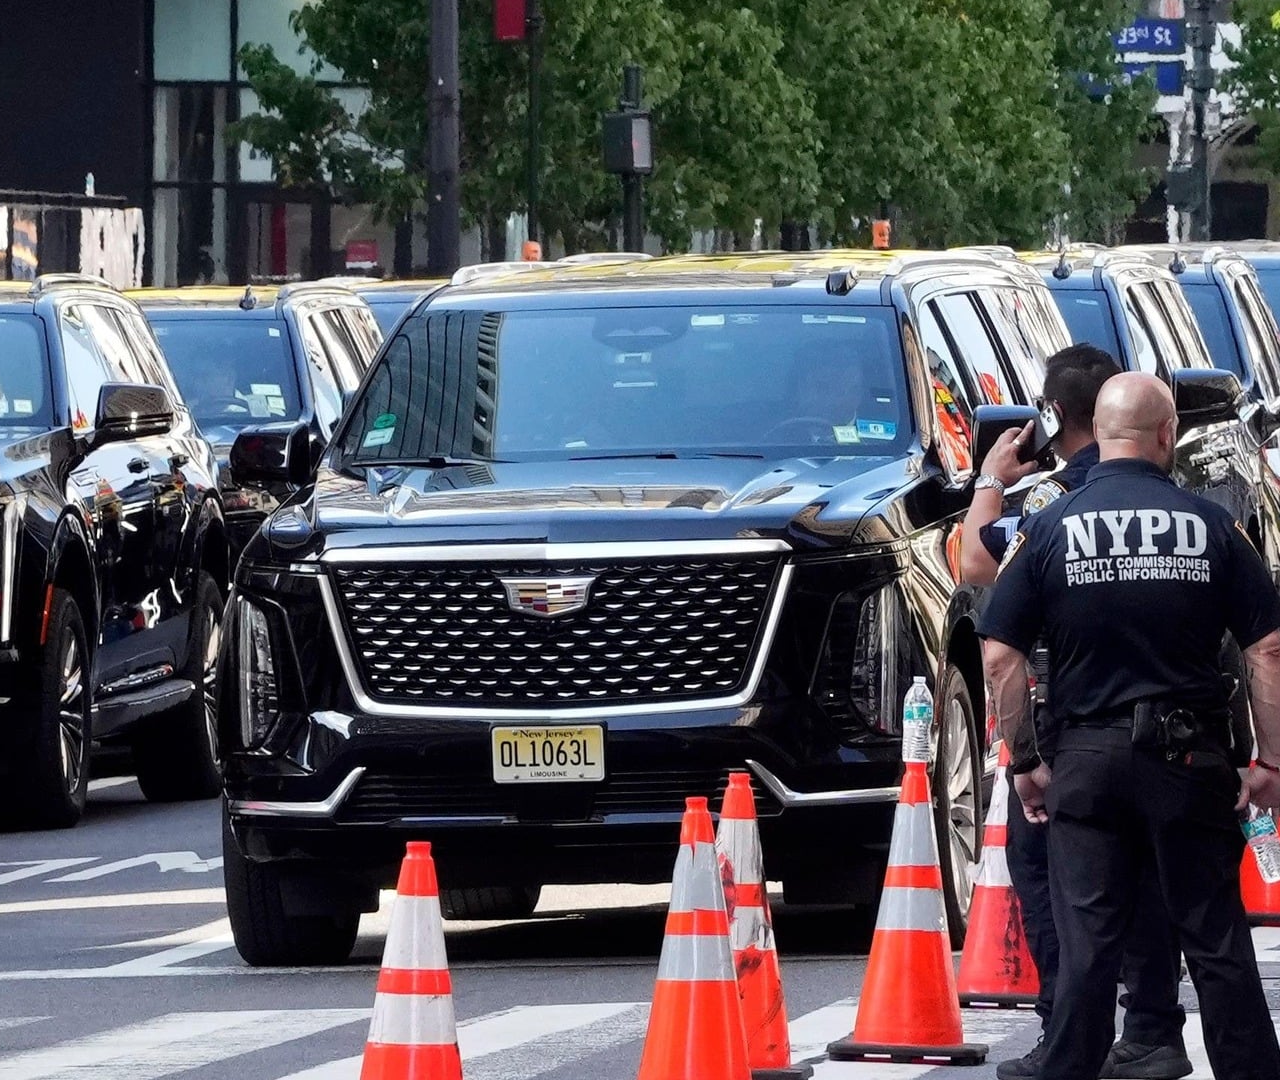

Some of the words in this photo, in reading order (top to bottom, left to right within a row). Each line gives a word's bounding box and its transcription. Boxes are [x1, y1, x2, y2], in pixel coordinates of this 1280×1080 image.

[1062, 508, 1208, 561] NYPD
[1065, 558, 1113, 575] DEPUTY
[1116, 556, 1210, 571] COMMISSIONER
[1067, 570, 1115, 587] PUBLIC
[1119, 569, 1211, 583] INFORMATION
[520, 729, 542, 738] New
[545, 729, 576, 740] Jersey
